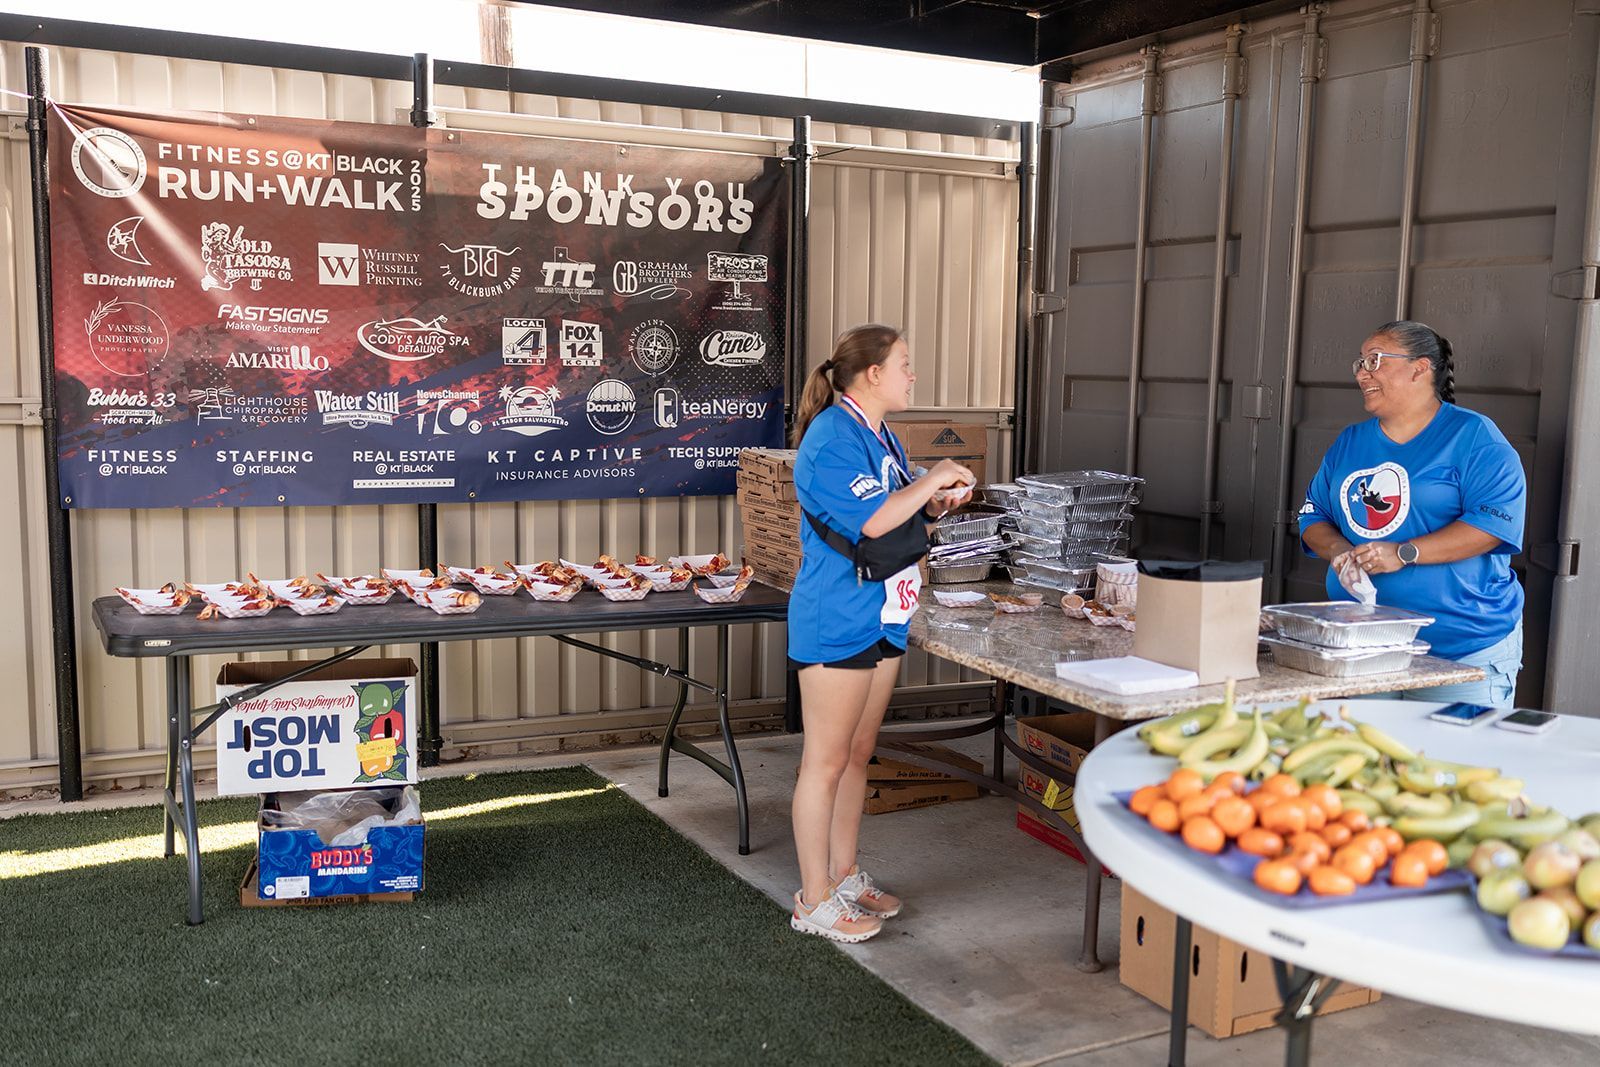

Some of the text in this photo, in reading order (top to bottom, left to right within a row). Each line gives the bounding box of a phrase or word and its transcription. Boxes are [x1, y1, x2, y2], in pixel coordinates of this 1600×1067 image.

[158, 166, 405, 212] RUN+WALK
[411, 160, 422, 212] 2025
[482, 163, 745, 203] THANK YOU
[476, 181, 755, 234] SPONSORS
[240, 239, 272, 253] OLD
[362, 248, 420, 262] WHITNEY
[224, 254, 291, 271] TASCOSA
[320, 256, 358, 279] W
[366, 261, 417, 274] RUSSELL
[638, 261, 688, 271] GRAHAM
[717, 257, 758, 270] FROST
[224, 269, 276, 279] BREWING
[366, 273, 422, 287] PRINTING
[542, 262, 596, 288] TTC
[613, 261, 638, 293] GB
[639, 269, 693, 279] BROTHERS
[448, 276, 503, 297] BLACKBURN
[503, 266, 522, 290] BAND
[108, 324, 152, 333] VANESSA
[225, 321, 320, 334] Make Your Statement
[565, 325, 596, 340] FOX
[98, 335, 164, 345] UNDERWOOD
[368, 334, 470, 346] CODY'S AUTO SPA
[628, 319, 664, 351] WAYPOINT
[397, 345, 444, 354] DETAILING
[514, 329, 544, 357] 4
[566, 343, 596, 358] 14
[87, 387, 176, 407] Bubba's 33
[224, 397, 308, 407] LIGHTHOUSE
[417, 390, 479, 400] NewsChannel
[314, 390, 400, 415] Water Still
[225, 407, 308, 415] CHIROPRACTIC
[101, 414, 127, 425] Food
[145, 415, 164, 425] All
[88, 450, 177, 462] FITNESS
[216, 450, 314, 463] STAFFING
[353, 450, 455, 462] REAL ESTATE
[488, 448, 642, 464] KT CAPTIVE
[668, 447, 704, 458] TECH
[496, 468, 636, 481] INSURANCE ADVISORS
[227, 714, 340, 750] MOST
[247, 748, 326, 780] TOP
[310, 847, 373, 869] BUDDY'S
[318, 867, 367, 877] MANDARINS
